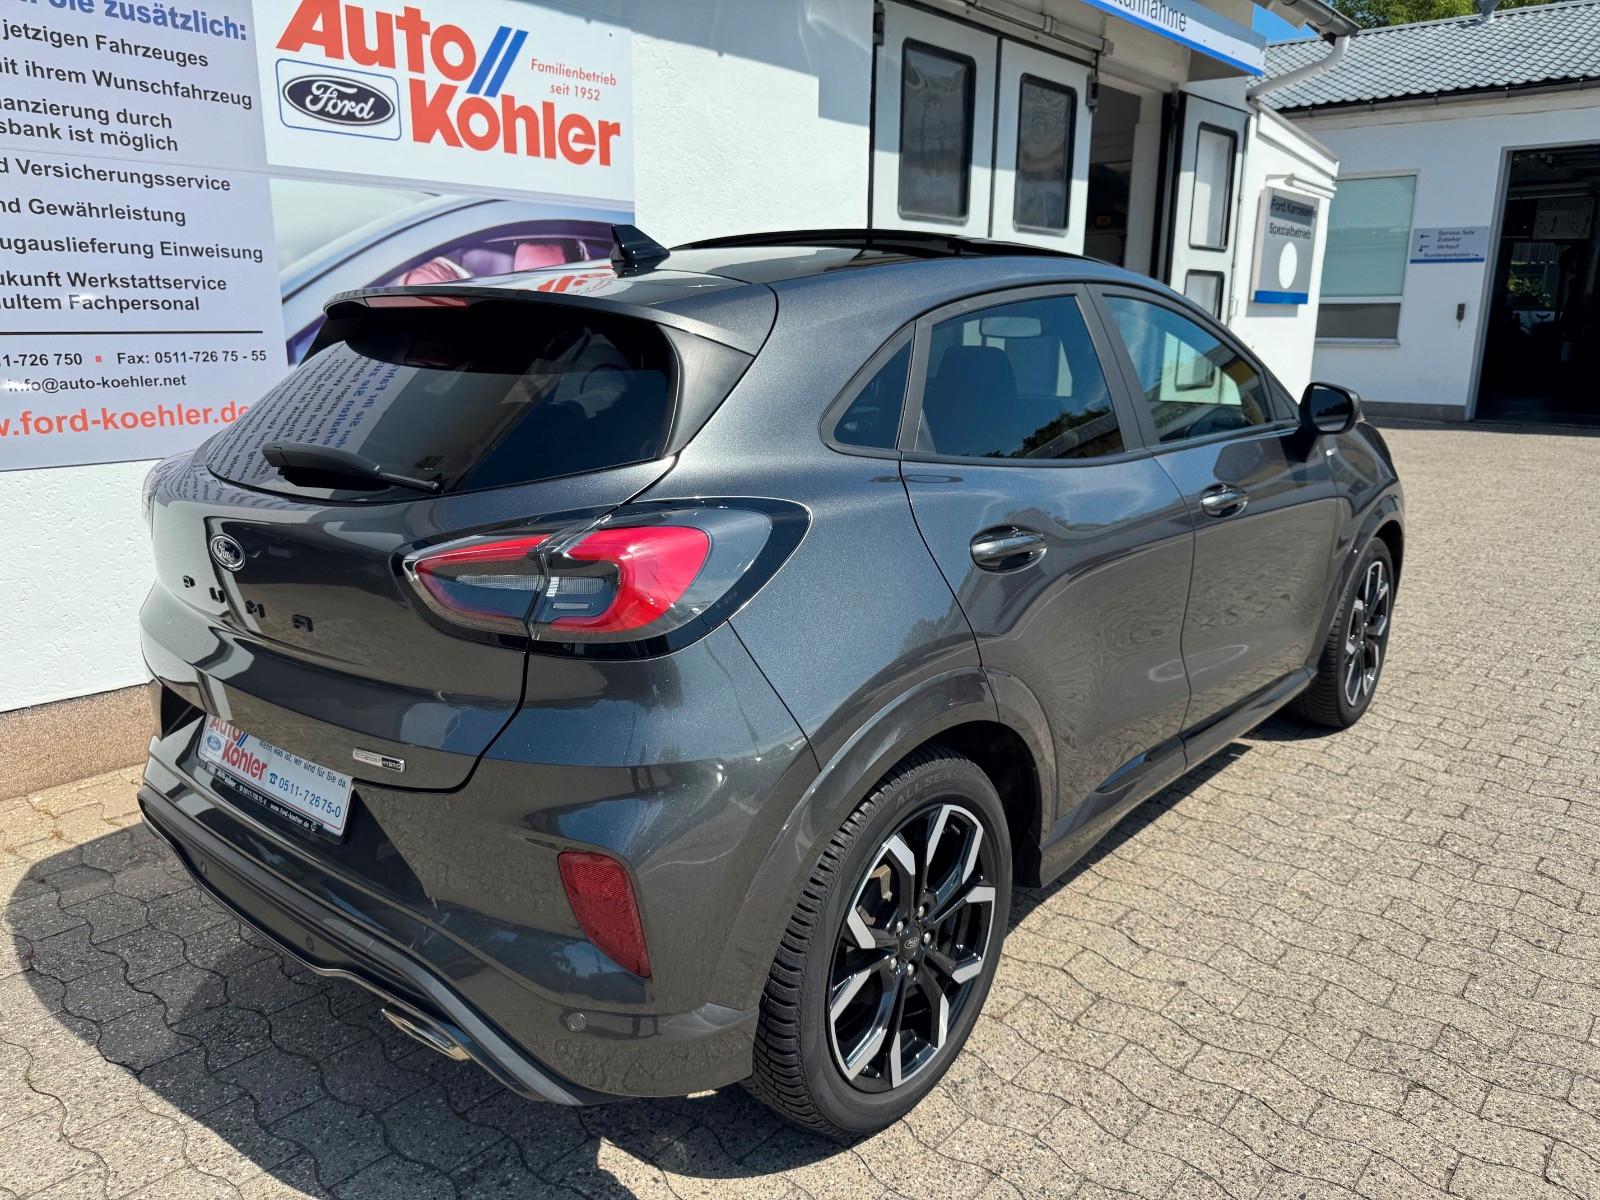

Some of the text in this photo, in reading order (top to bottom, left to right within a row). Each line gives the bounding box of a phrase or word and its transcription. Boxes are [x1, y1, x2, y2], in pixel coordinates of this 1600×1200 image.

[104, 0, 247, 41] zusätzlich:
[3, 19, 209, 67] jetzigen Fahrzeuges
[276, 0, 476, 81] Auto
[0, 57, 252, 110] it ihrem Wunschfahrzeug
[531, 58, 616, 86] Familienbetrieb
[305, 80, 375, 119] Ford
[550, 83, 601, 102] seit 1952
[0, 97, 173, 129] anzierung durch
[68, 125, 94, 143] ist
[100, 131, 178, 151] möglich
[15, 158, 231, 191] Versicherungsservice
[28, 199, 186, 227] Gewährleistung
[0, 236, 263, 263] ugauslieferung Einweisung
[67, 271, 227, 290] Werkstattservice
[0, 293, 200, 314] ultem Fachpersonal
[0, 352, 49, 367] 1-726
[53, 352, 82, 366] 750
[117, 352, 150, 364] Fax:
[155, 351, 218, 364] 0511-726
[222, 350, 238, 362] 75
[251, 349, 267, 362] 55
[8, 375, 187, 394] ifo@auto-koehler.net
[182, 574, 314, 633] PUMA
[327, 770, 337, 783] Sie
